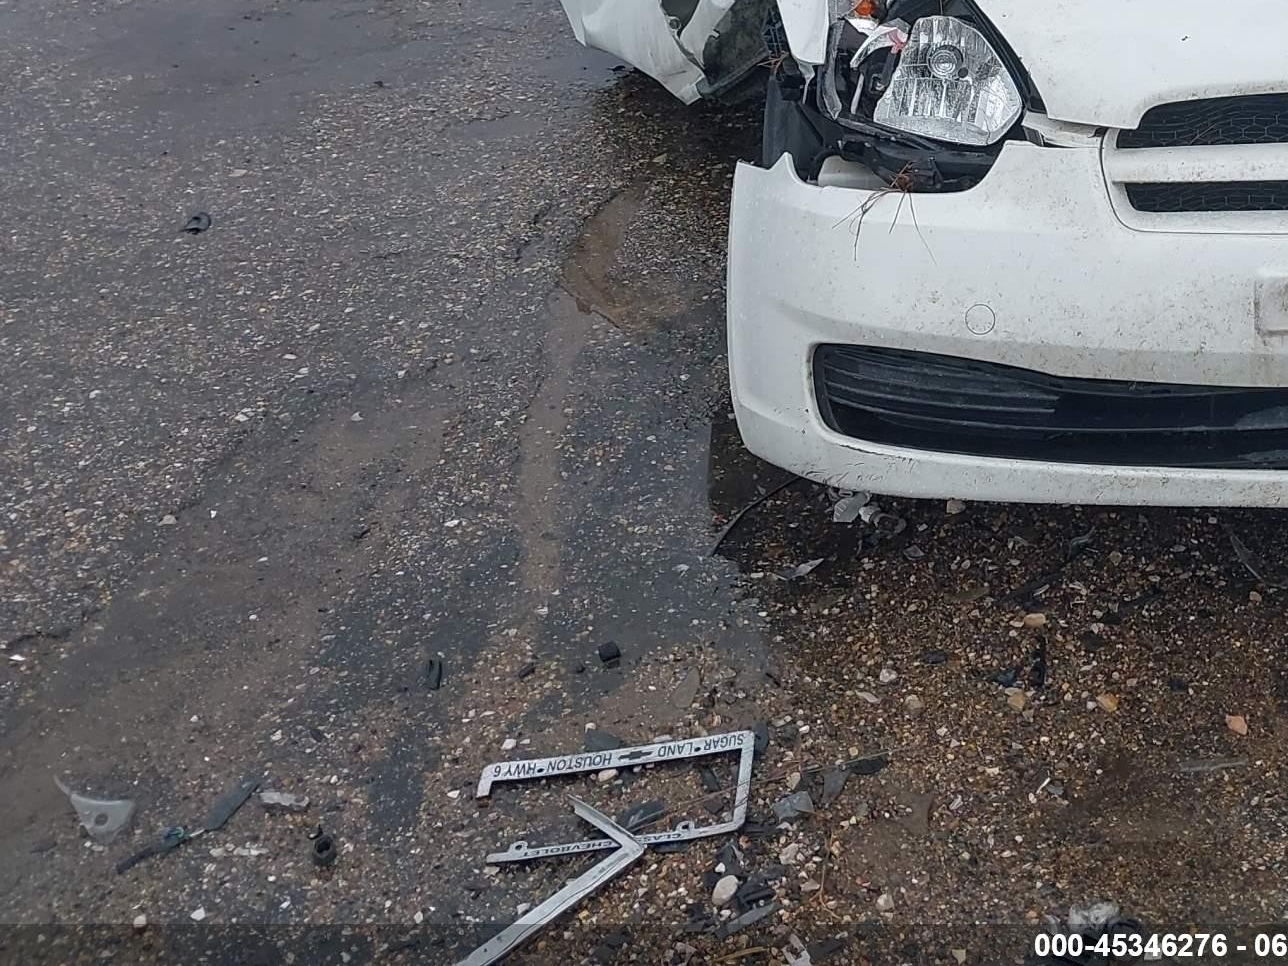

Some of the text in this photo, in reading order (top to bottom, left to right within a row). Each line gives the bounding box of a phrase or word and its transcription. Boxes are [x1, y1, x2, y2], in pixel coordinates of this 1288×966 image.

[493, 733, 744, 778] SUGAR LAND HOUSTON HWY 6
[523, 841, 613, 858] CHEVROLET
